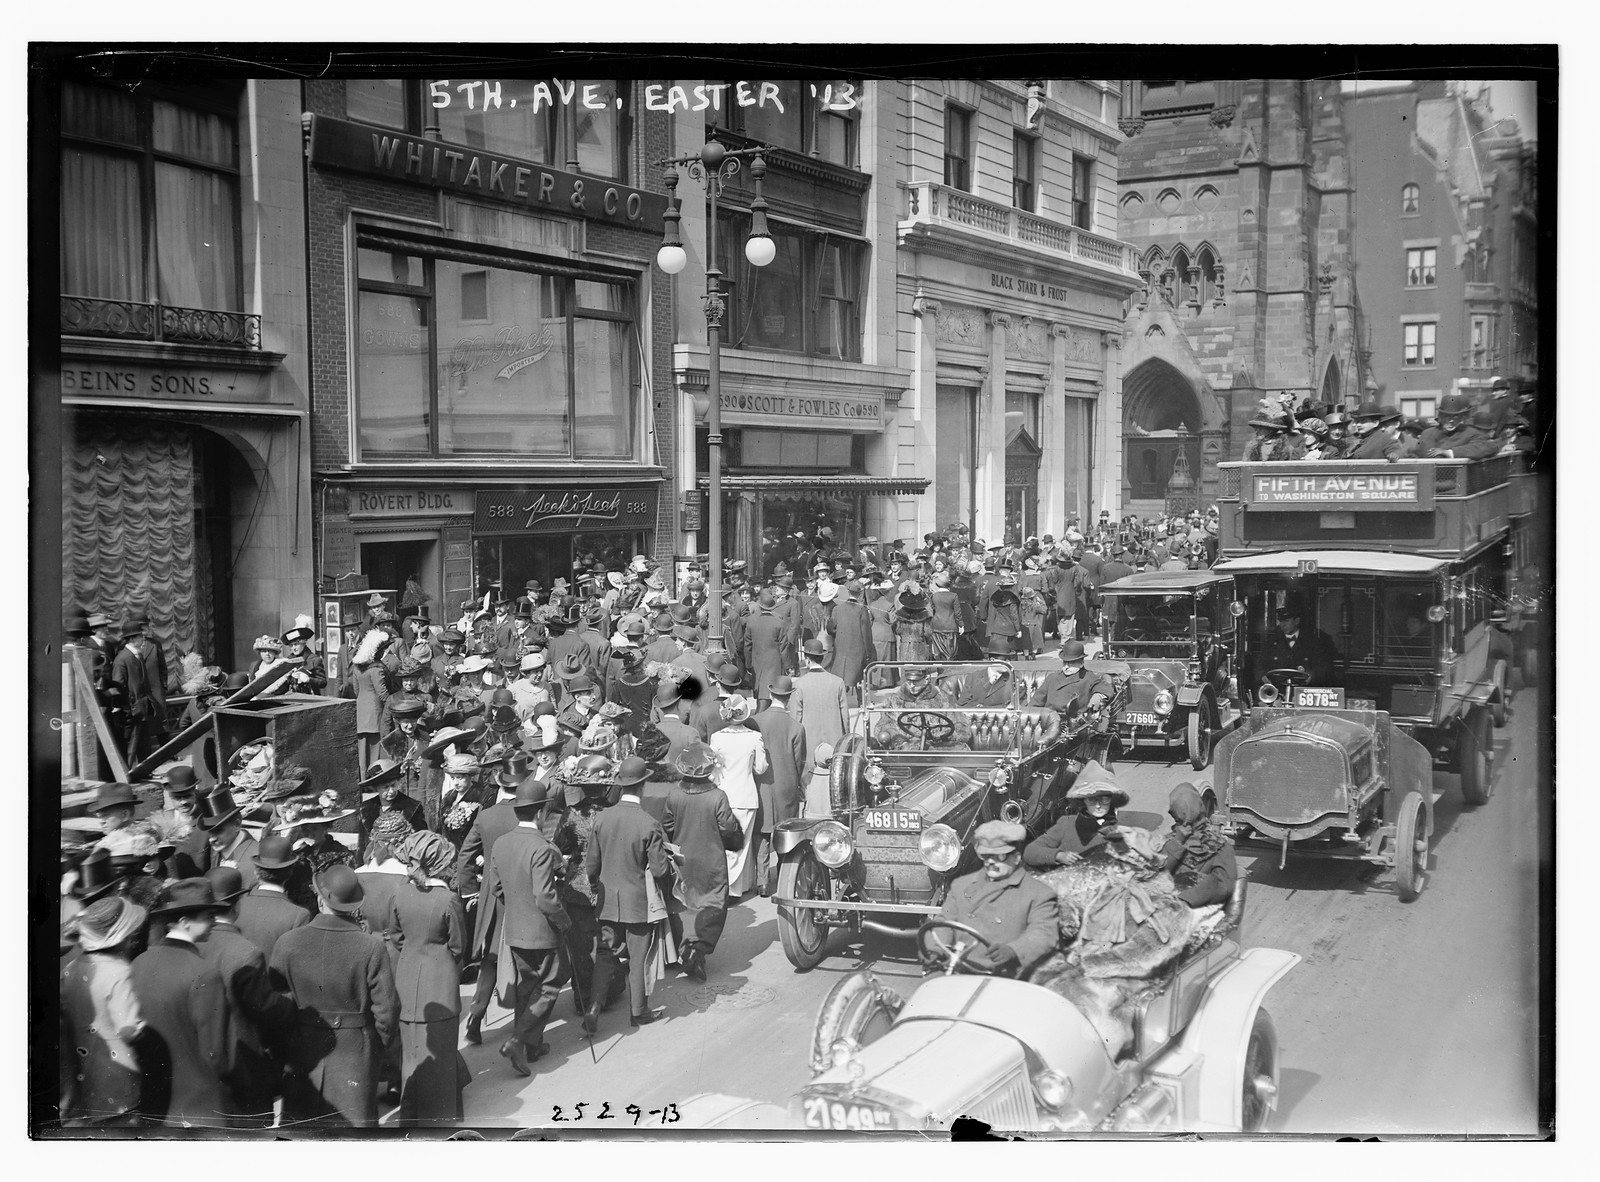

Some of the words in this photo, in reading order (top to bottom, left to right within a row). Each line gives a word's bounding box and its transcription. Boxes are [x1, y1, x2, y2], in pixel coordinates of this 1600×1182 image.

[372, 133, 555, 203] WHITAKER
[570, 179, 586, 211] &
[604, 187, 645, 222] CO.
[991, 273, 1013, 291] BLACK
[1017, 279, 1038, 296] STARR
[1041, 284, 1046, 297] &
[1048, 286, 1068, 302] FROST
[363, 329, 420, 349] GOWNS
[506, 357, 535, 375] IMPORTER
[63, 369, 137, 391] BEIN'S
[151, 374, 214, 395] SONS.
[747, 395, 786, 413] SCOTT
[788, 398, 795, 413] &
[799, 399, 840, 416] FOWLES
[862, 404, 879, 417] 590
[1258, 476, 1316, 492] FIFTH
[1324, 476, 1416, 491] AVENUE
[360, 492, 413, 511] ROVERT
[417, 491, 453, 509] BLDG.
[1259, 493, 1269, 501] TO
[1274, 492, 1355, 501] WASHINGTON
[1361, 491, 1416, 500] SQUARE
[489, 505, 515, 518] 588
[626, 502, 647, 514] 588
[1301, 560, 1316, 573] 10
[1298, 693, 1329, 707] 6878
[1354, 699, 1369, 710] 22
[1126, 712, 1153, 724] 27660
[866, 811, 909, 829] 46815
[804, 1097, 876, 1130] 21949
